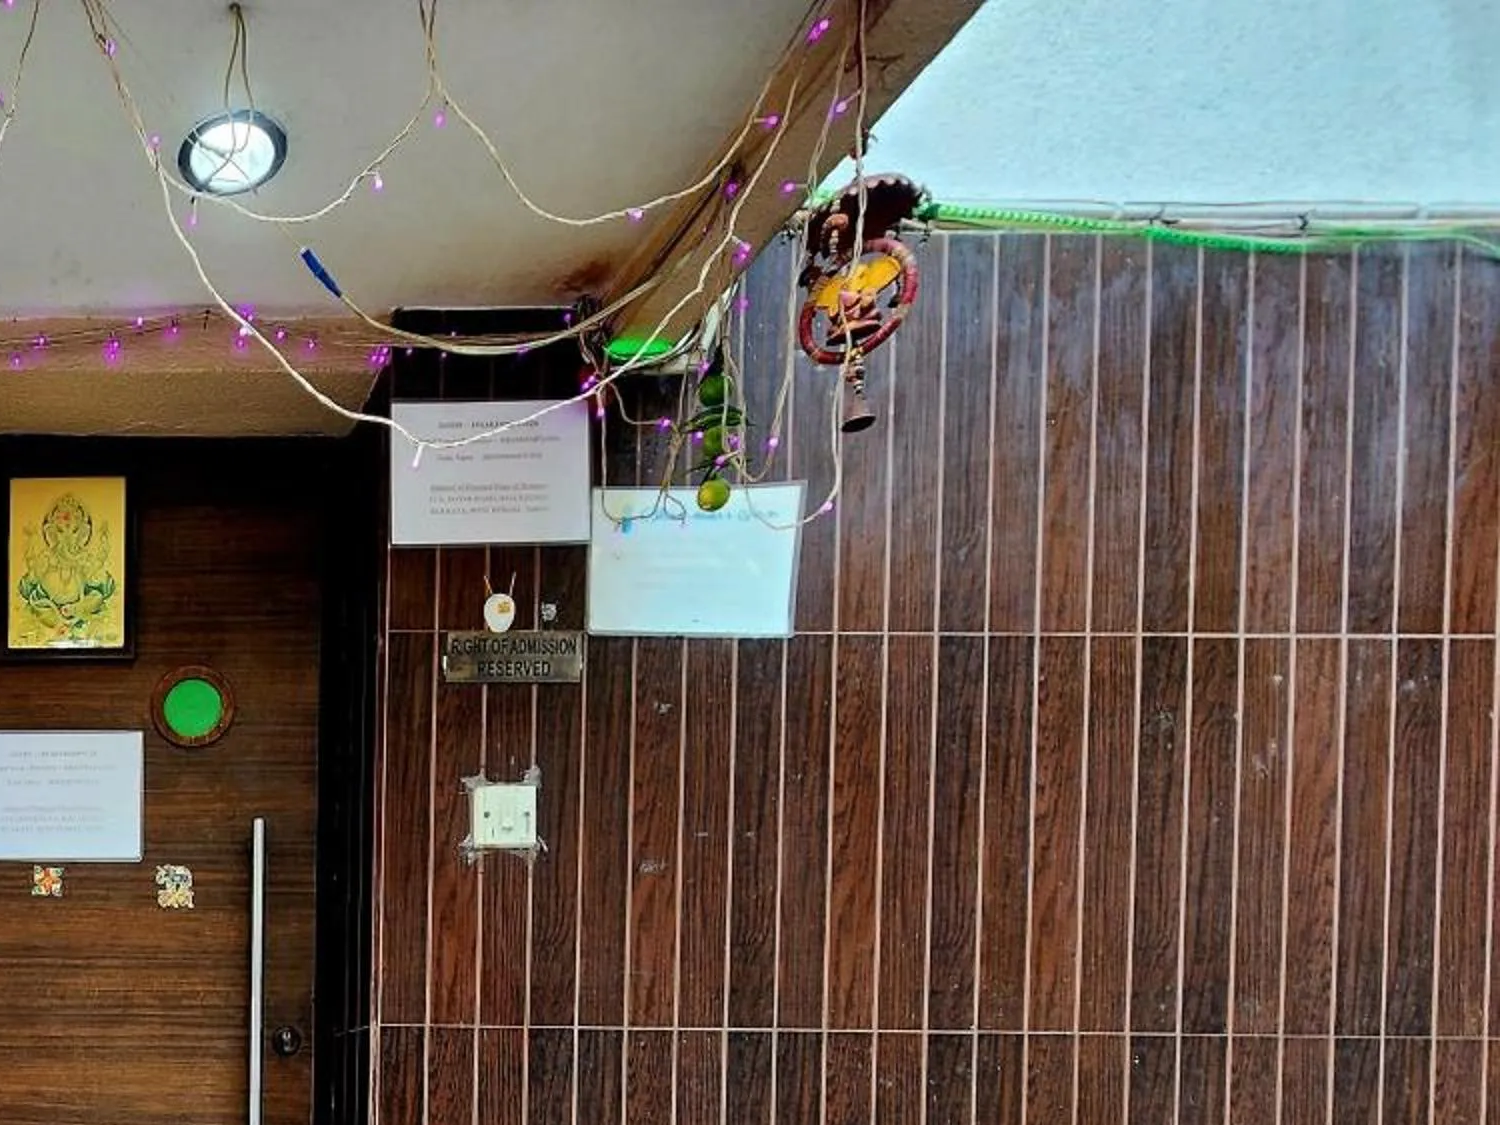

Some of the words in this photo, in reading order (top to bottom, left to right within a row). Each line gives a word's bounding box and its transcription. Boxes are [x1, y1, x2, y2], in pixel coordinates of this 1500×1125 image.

[451, 638, 487, 655] RIGHT
[491, 638, 508, 655] OF
[510, 638, 577, 655] ADMISSION
[478, 661, 551, 677] RESERVED
